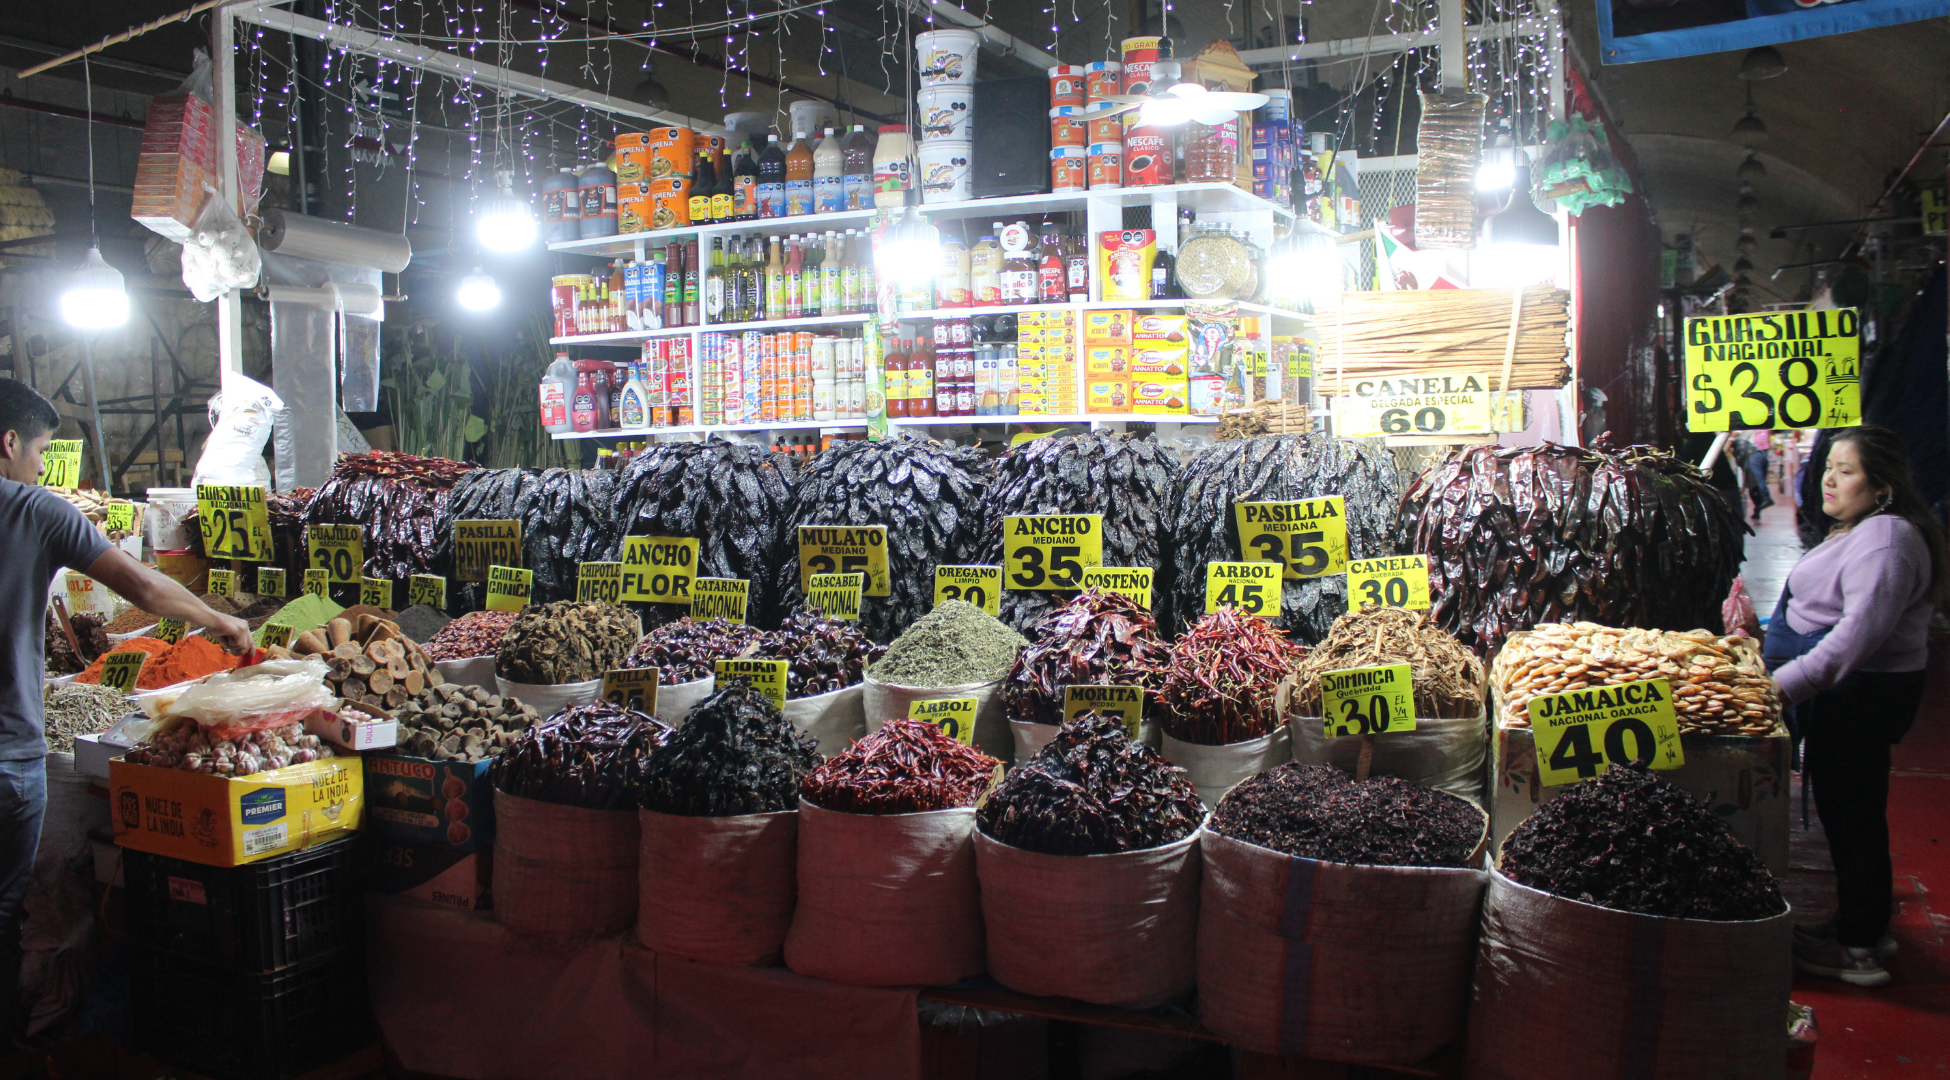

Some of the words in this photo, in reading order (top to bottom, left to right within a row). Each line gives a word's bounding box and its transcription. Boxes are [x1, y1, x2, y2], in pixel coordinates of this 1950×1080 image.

[1124, 63, 1151, 74] NESCA
[350, 122, 383, 138] ETIB
[1110, 252, 1138, 260] ABUELITA
[1704, 340, 1832, 362] NACIONAL
[1356, 376, 1484, 398] CANELA
[1371, 398, 1421, 408] DELGADA
[1425, 394, 1474, 405] ESPECIAL
[1380, 406, 1446, 434] 60
[47, 440, 82, 454] MARINDO
[211, 501, 252, 510] NACIONAL
[1244, 500, 1338, 523] PASILLA
[253, 526, 263, 537] EL
[310, 527, 358, 541] GUAJILLO
[459, 526, 516, 539] PASILLA
[1014, 518, 1090, 536] ANCHO
[1263, 521, 1318, 532] MEDIANA
[318, 540, 350, 548] NACIONAL
[802, 529, 883, 547] MULATO
[1032, 536, 1075, 544] MEDIANO
[624, 543, 691, 567] ANCHO
[821, 546, 866, 554] MEDIANO
[1250, 531, 1329, 575] 35
[314, 548, 354, 580] 30
[457, 541, 519, 576] PRIMERA
[1350, 558, 1425, 574] CANELA
[211, 570, 231, 578] MOLE
[306, 570, 325, 578] MOLE
[491, 568, 522, 582] CHILE
[580, 563, 620, 578] CHIPOTLE
[939, 567, 997, 578] OREGANO
[1011, 546, 1084, 588] 35
[1213, 565, 1274, 578] ARBOL
[210, 581, 226, 594] 35
[260, 579, 277, 594] 30
[306, 581, 322, 594] 30
[363, 579, 386, 588] MOLE
[623, 572, 690, 597] FLOR
[695, 579, 746, 593] CATARINA
[811, 575, 860, 588] CASCABEL
[1084, 570, 1149, 589] COSTEÑO
[363, 590, 381, 606] 25
[579, 579, 619, 602] MECO
[941, 585, 986, 609] 30
[1358, 577, 1409, 607] 30
[692, 593, 744, 620] NACIONAL
[808, 590, 858, 615] NACIONAL
[1216, 585, 1264, 614] 45
[106, 653, 142, 666] CHARAL
[725, 662, 777, 673] MORA
[102, 666, 129, 689] 30
[608, 670, 651, 684] PULLA
[716, 672, 776, 683] CHITLE
[1321, 670, 1394, 692] JAMAICA
[1070, 688, 1139, 702] MORITA
[1336, 685, 1382, 699] Quebrada
[914, 702, 972, 715] ÁRBOL
[1539, 682, 1664, 719] JAMAICA
[1324, 695, 1390, 736] $30
[1394, 695, 1406, 706] EL
[1549, 712, 1608, 728] NACIONAL
[1610, 704, 1658, 720] OAXACA
[1550, 717, 1657, 779] 40
[368, 758, 435, 779] ANTUCO
[312, 771, 336, 789] NUEZ
[338, 768, 349, 782] DE
[313, 789, 324, 803] LA
[327, 783, 349, 800] INDIA
[145, 796, 169, 816] NUEZ
[171, 801, 183, 819] DE
[245, 802, 283, 817] PREMIER
[147, 815, 158, 832] LA
[160, 818, 185, 838] INDIA
[432, 891, 469, 907] PRUNES
